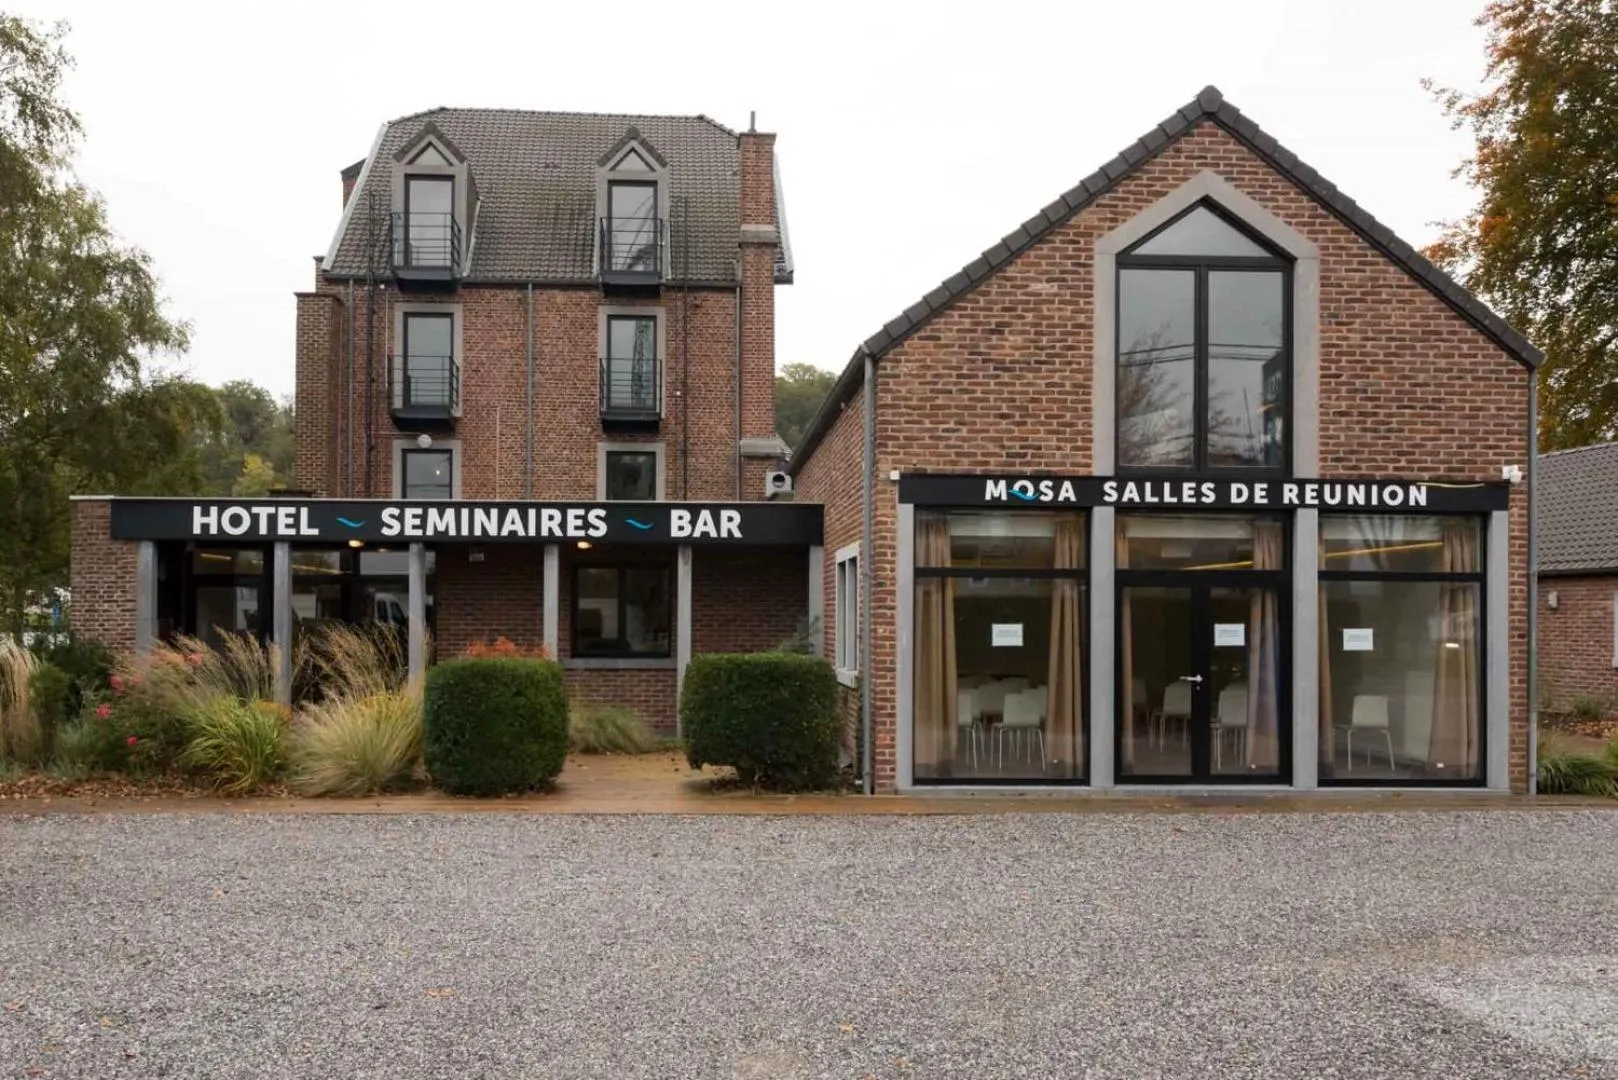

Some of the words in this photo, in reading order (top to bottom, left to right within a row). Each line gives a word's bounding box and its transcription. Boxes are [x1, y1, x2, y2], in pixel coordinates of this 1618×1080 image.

[984, 479, 1077, 503] MOSA
[1102, 481, 1217, 506] SALLES
[1230, 483, 1269, 506] DE
[1282, 483, 1429, 508] REUNION
[192, 505, 320, 536] HOTEL
[380, 507, 608, 538] SEMINAIRES
[670, 509, 743, 539] BAR
